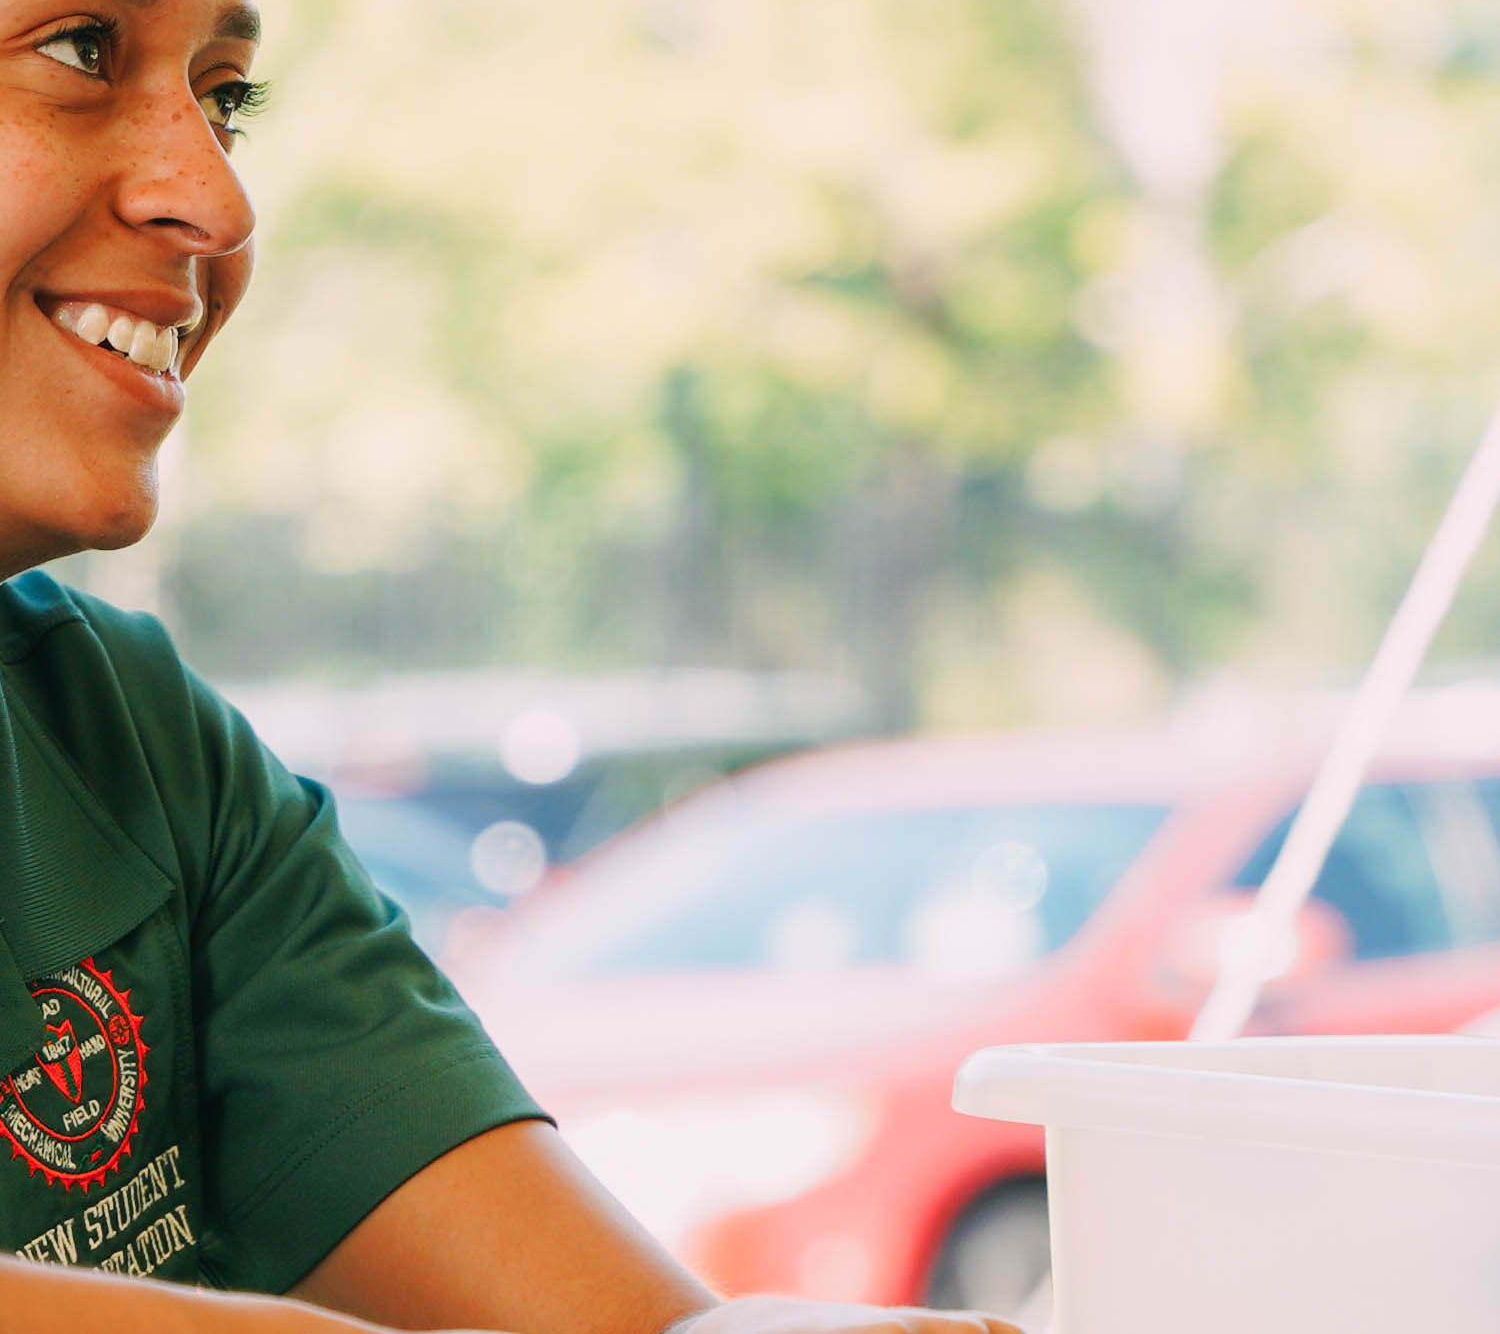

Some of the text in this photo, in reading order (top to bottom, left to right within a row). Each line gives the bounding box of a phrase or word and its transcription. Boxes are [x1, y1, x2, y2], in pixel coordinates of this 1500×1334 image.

[80, 1034, 106, 1060] HAND
[0, 1049, 138, 1170] MECHANICAL UNIVERSITY
[62, 1099, 100, 1132] FIELD
[83, 1145, 186, 1250] STUDENT
